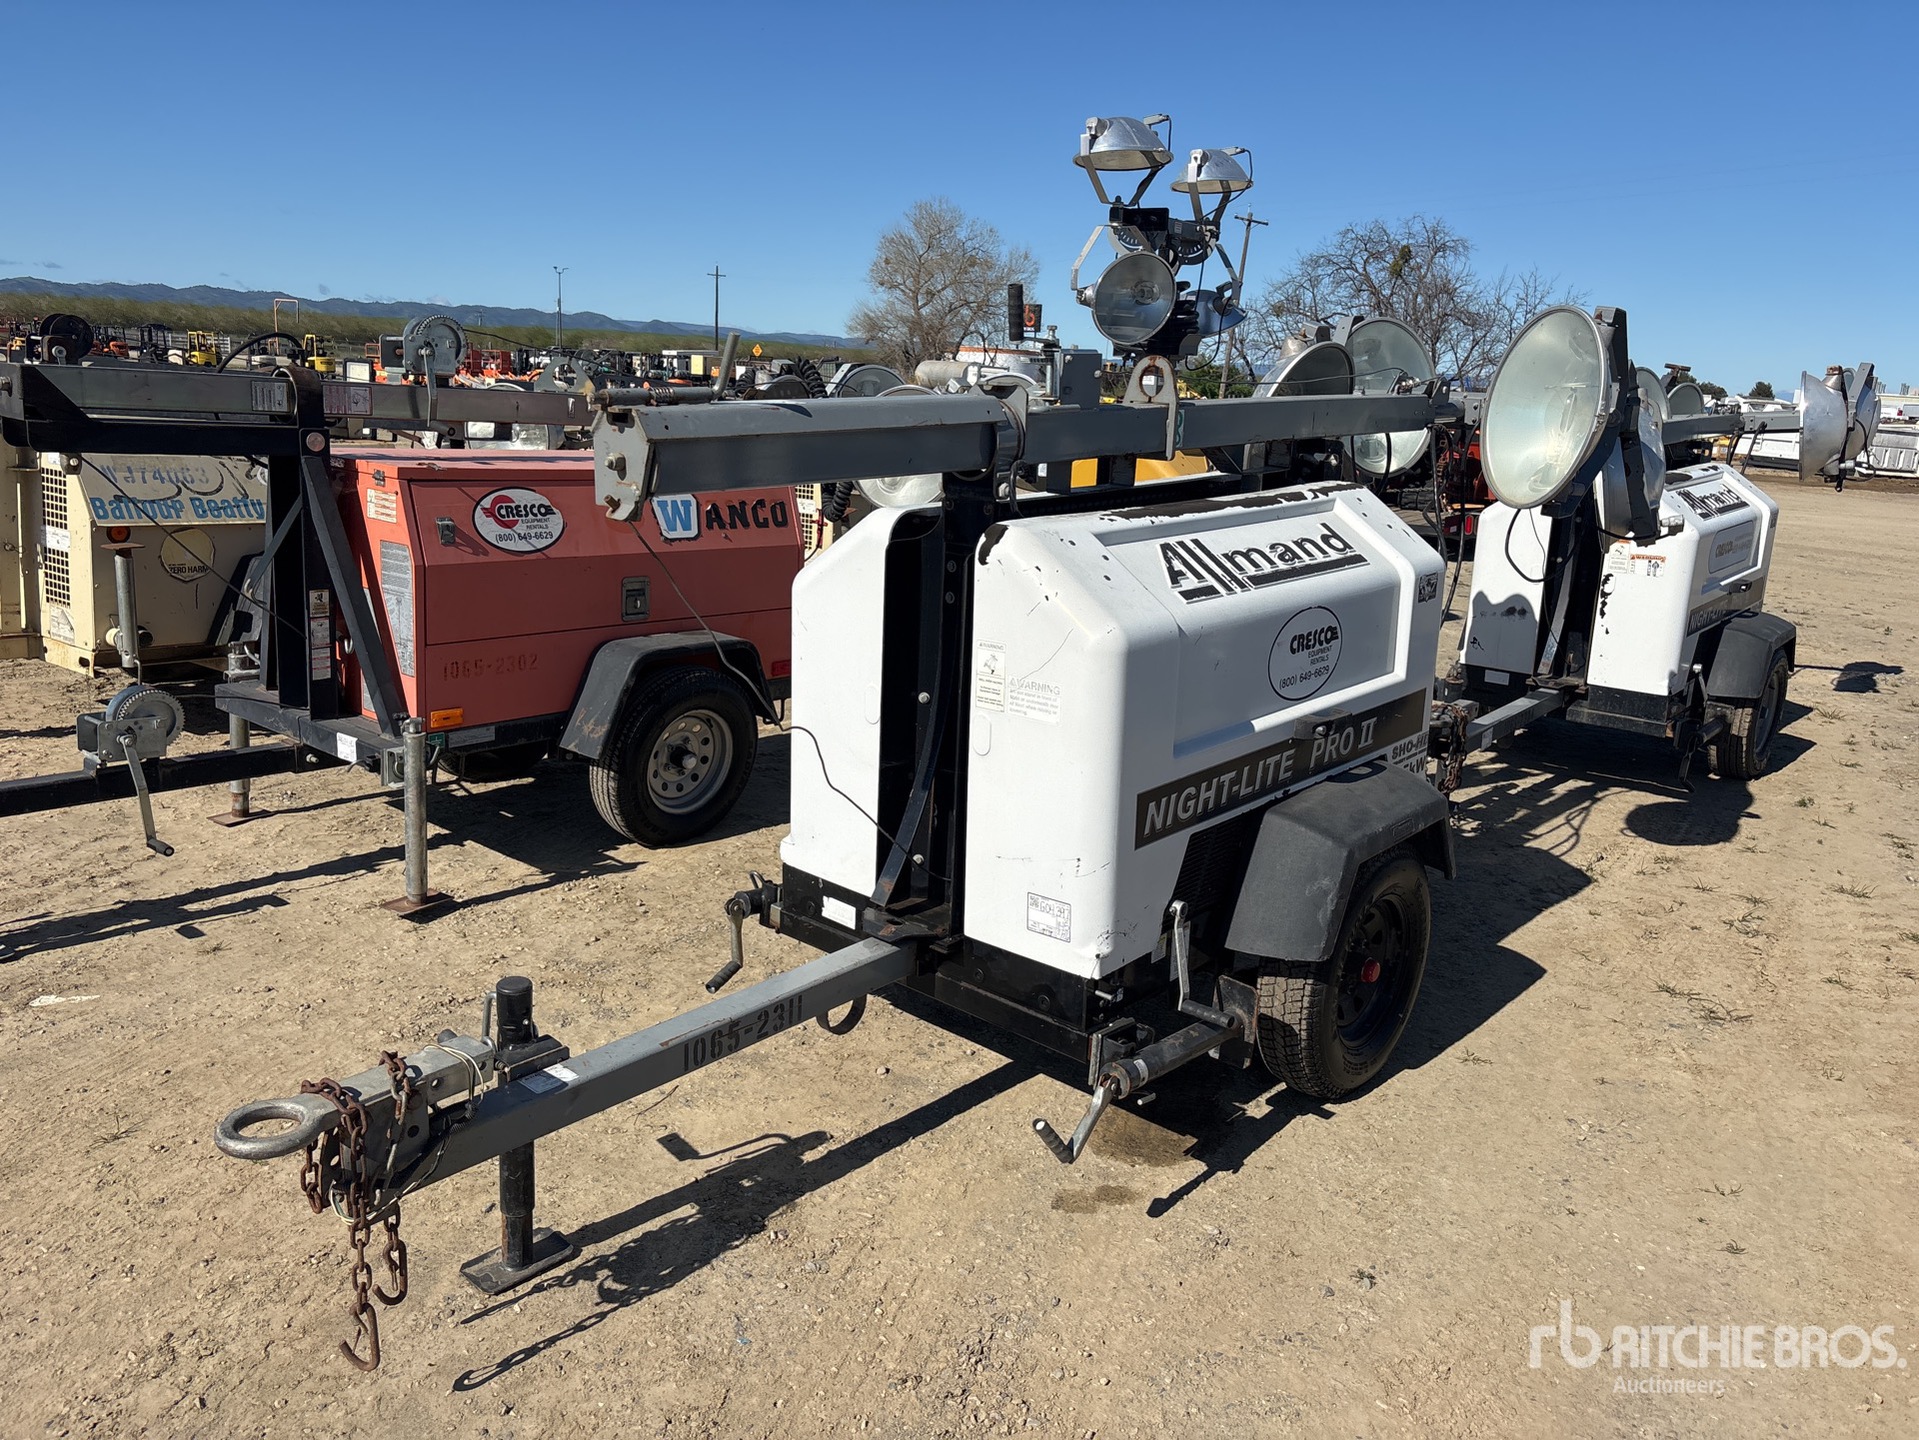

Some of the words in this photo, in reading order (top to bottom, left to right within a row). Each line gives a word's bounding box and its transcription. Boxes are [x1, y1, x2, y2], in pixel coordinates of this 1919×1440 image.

[496, 503, 556, 519] CRESCO
[495, 533, 516, 544] (800)
[518, 531, 554, 541] 649-6629
[1159, 522, 1356, 596] Allmand
[1289, 625, 1339, 655] CRESCO
[1279, 674, 1297, 690] (800)
[1299, 665, 1330, 683] 649-6629
[1143, 747, 1296, 837] NIGHT-LITE
[1308, 730, 1354, 775] PRO
[683, 994, 804, 1072] 1065-2311
